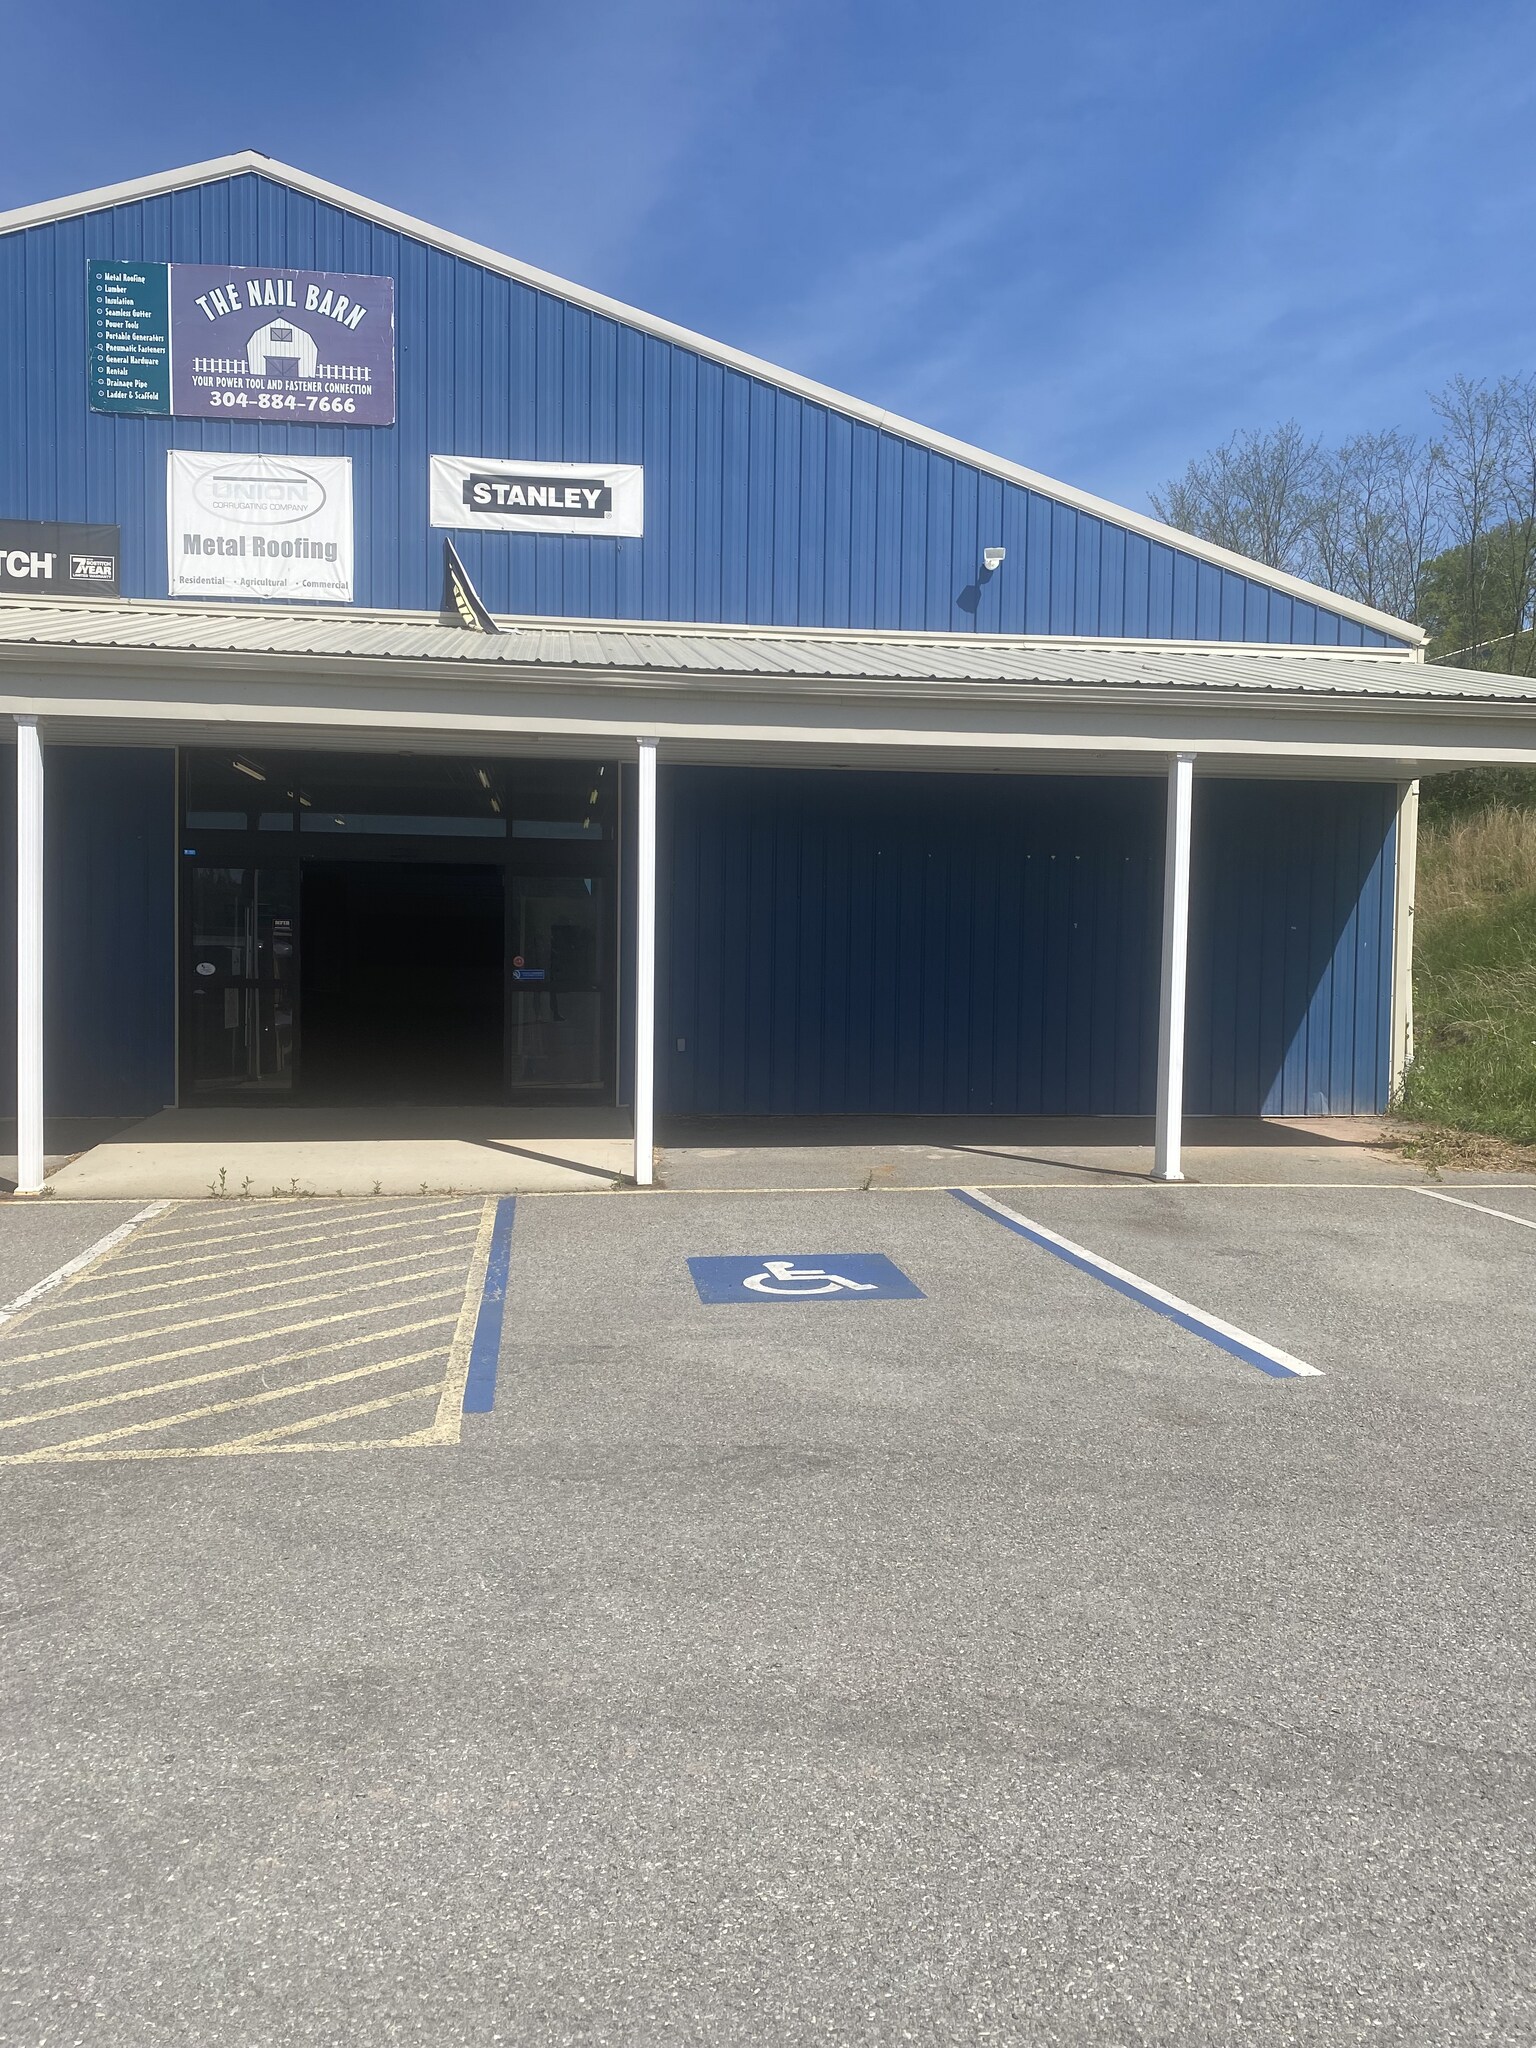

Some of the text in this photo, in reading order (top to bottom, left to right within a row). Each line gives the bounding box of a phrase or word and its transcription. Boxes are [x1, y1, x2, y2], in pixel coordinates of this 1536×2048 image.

[105, 273, 146, 284] Metal Roofing
[105, 285, 127, 293] Lumber
[105, 296, 134, 306] Insulation
[195, 279, 368, 331] THE NAIL BARN
[105, 308, 152, 318] Seamless Gutter
[106, 320, 139, 329] Power Tools
[106, 331, 164, 342] Portable Generators
[106, 343, 165, 354] Pneumatic Fasteners
[106, 355, 159, 365] General Hardware
[106, 367, 128, 375] Rentals
[107, 379, 148, 389] Drainage Pipe
[192, 376, 372, 395] YOUR POWER TOOL AND FASTENER CONNECTION
[107, 390, 159, 400] Ladder & Scaffold
[210, 391, 356, 413] 304-884-7666
[212, 483, 308, 501] UNION
[473, 482, 602, 509] STANLEY
[213, 502, 308, 511] CORRUGATING COMPANY
[183, 534, 337, 562] Metal Roofing
[73, 558, 111, 575] 7 YEAR
[179, 576, 348, 589] Residential Agricultural Commercial
